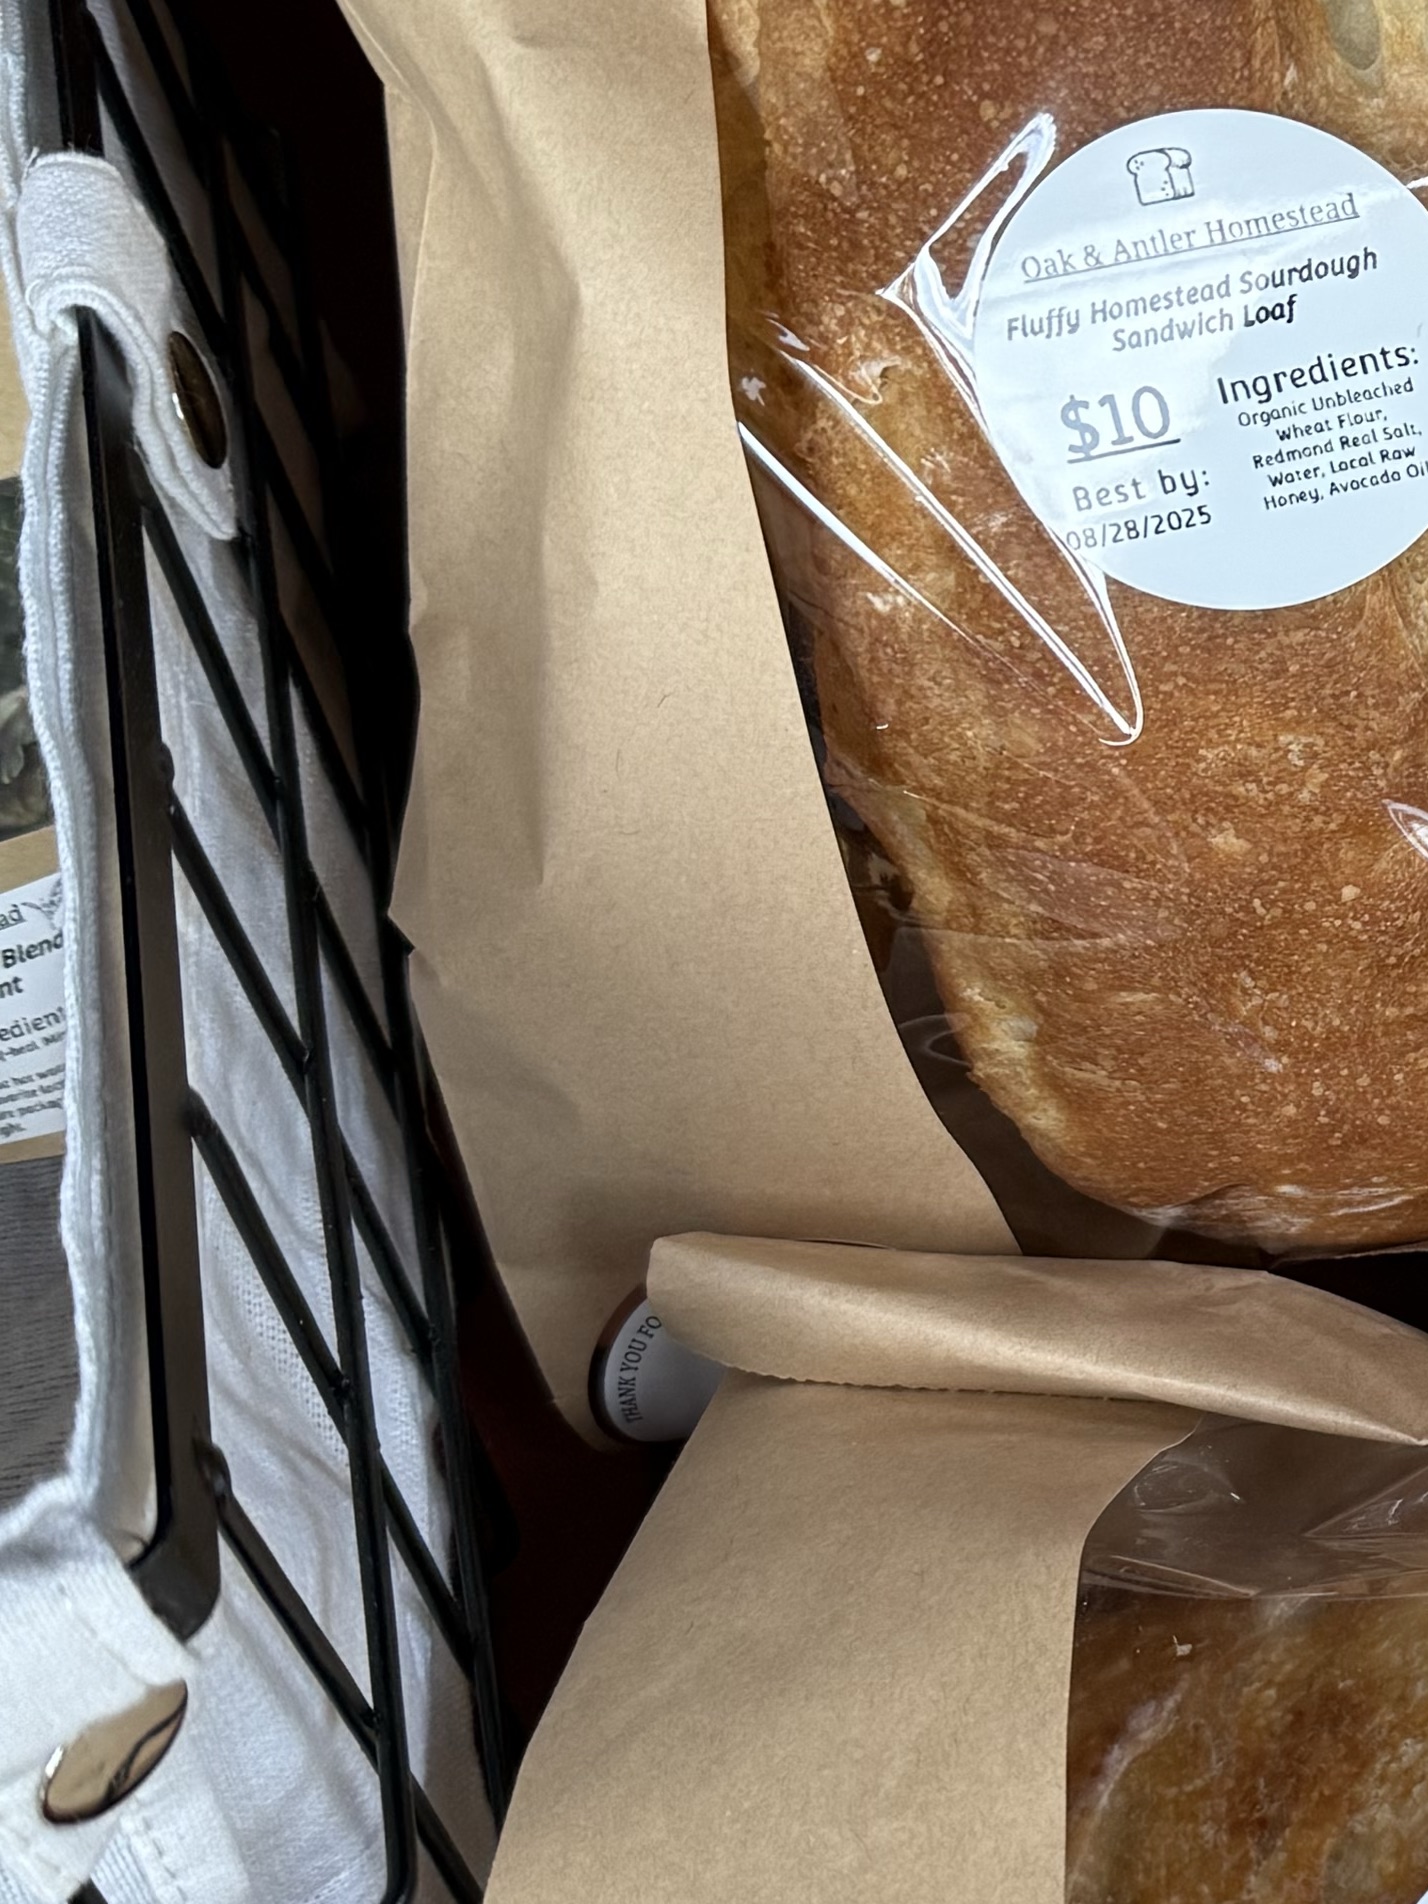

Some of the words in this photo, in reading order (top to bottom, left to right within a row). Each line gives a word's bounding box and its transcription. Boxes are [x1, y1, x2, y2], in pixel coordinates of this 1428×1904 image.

[1021, 249, 1074, 281] Oak
[1083, 242, 1102, 266] &
[1114, 228, 1196, 263] Antler
[1205, 193, 1360, 242] Homestead
[1006, 307, 1080, 341] Fluffy
[1090, 275, 1232, 323] Homestead
[1240, 247, 1379, 295] Sourdough
[1112, 309, 1234, 352] Sandwich
[1244, 294, 1298, 328] Loaf
[1217, 343, 1420, 405] Ingredients:
[1059, 386, 1172, 459] $10
[1238, 400, 1308, 427] Organic
[1312, 377, 1415, 412] Unbleached
[1276, 419, 1333, 441] Wheat
[1338, 408, 1388, 429] Flour,
[1253, 439, 1335, 469] Redmond
[1339, 429, 1378, 450] Real
[1383, 422, 1422, 441] Salt,
[1268, 465, 1325, 487] Water,
[1330, 451, 1375, 474] Local
[1379, 446, 1416, 464] Raw
[1072, 478, 1147, 512] Best
[1158, 465, 1210, 498] by:
[1264, 487, 1324, 510] Honey,
[1329, 469, 1401, 496] Avocado
[1065, 505, 1213, 552] 08/28/2025
[636, 1315, 662, 1339] FO
[619, 1338, 648, 1373] YOU
[618, 1377, 643, 1424] THANK
